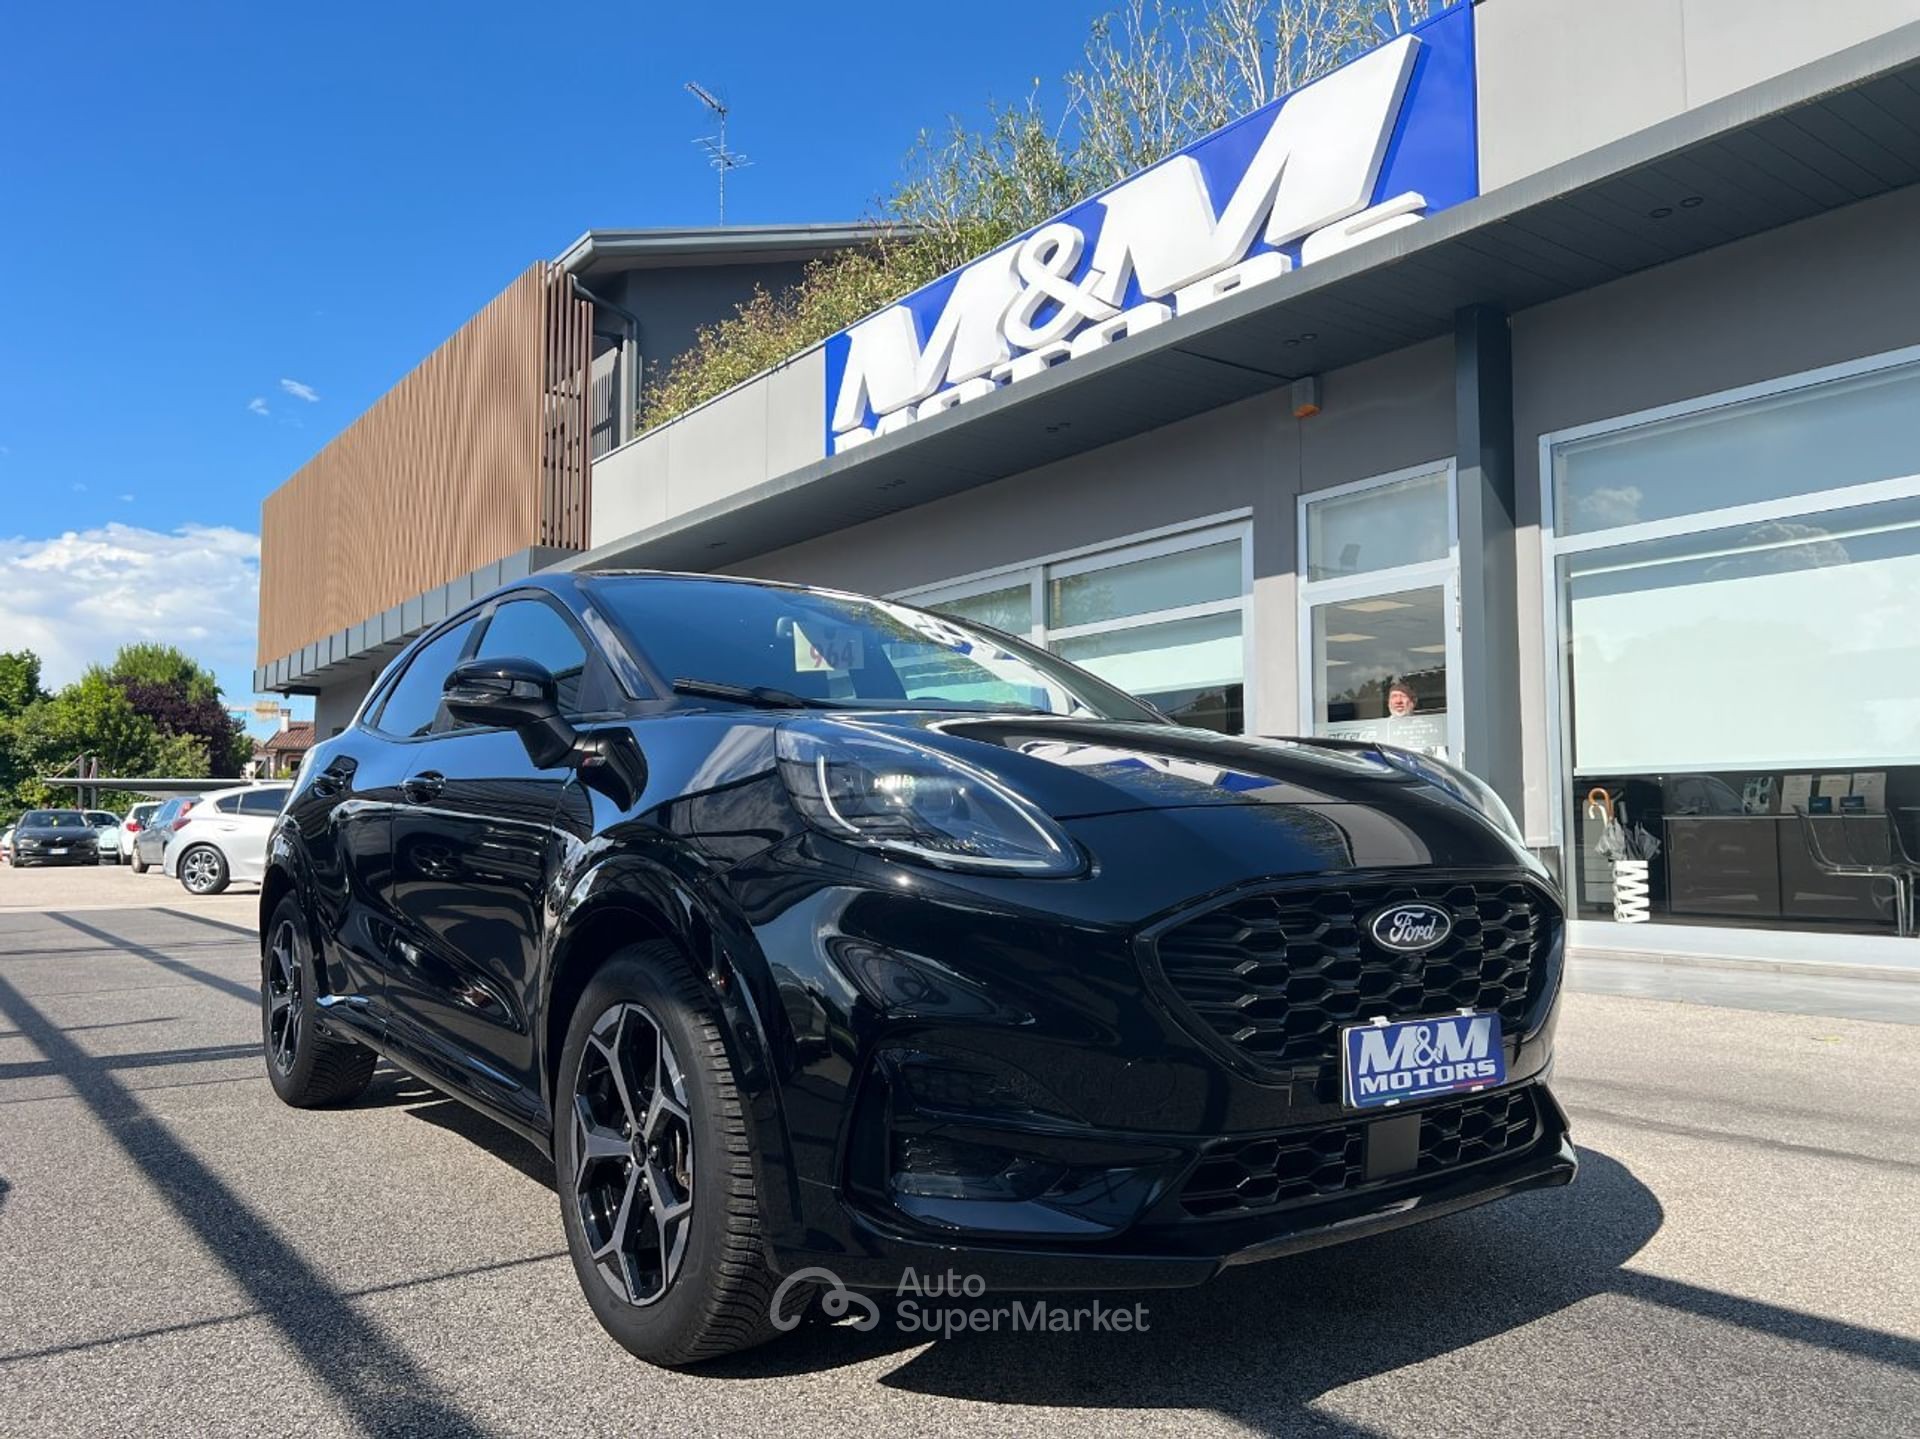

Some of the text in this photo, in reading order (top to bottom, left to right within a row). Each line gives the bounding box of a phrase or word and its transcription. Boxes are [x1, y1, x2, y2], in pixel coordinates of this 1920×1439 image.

[832, 33, 1422, 433] M&M
[809, 641, 854, 668] 964
[1389, 911, 1437, 943] Ford
[1358, 1017, 1492, 1075] M&M
[1359, 1059, 1496, 1095] MOTORS
